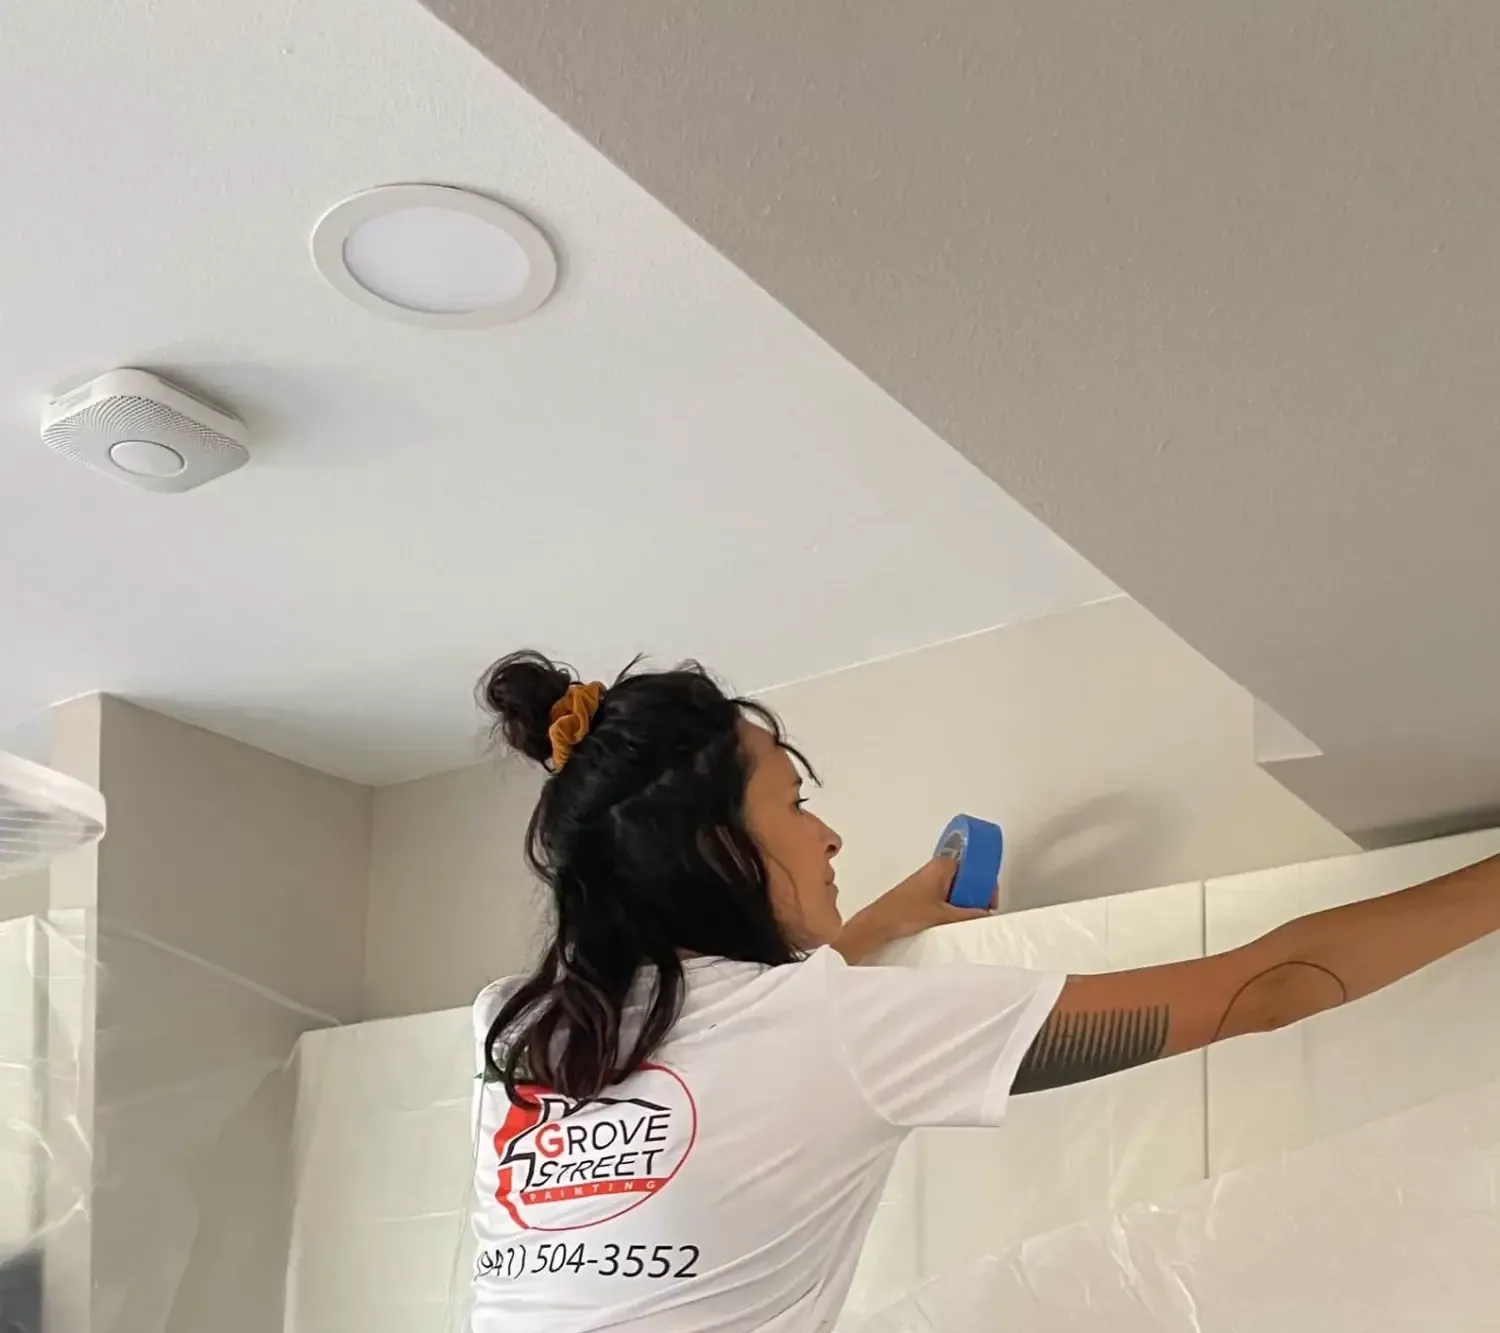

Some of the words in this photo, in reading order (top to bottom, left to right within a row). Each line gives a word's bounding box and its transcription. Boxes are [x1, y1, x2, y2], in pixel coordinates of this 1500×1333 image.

[535, 1113, 672, 1157] GROVE
[531, 1149, 665, 1187] STREET
[529, 1180, 658, 1202] PAINTING
[530, 1242, 701, 1279] 504-3552
